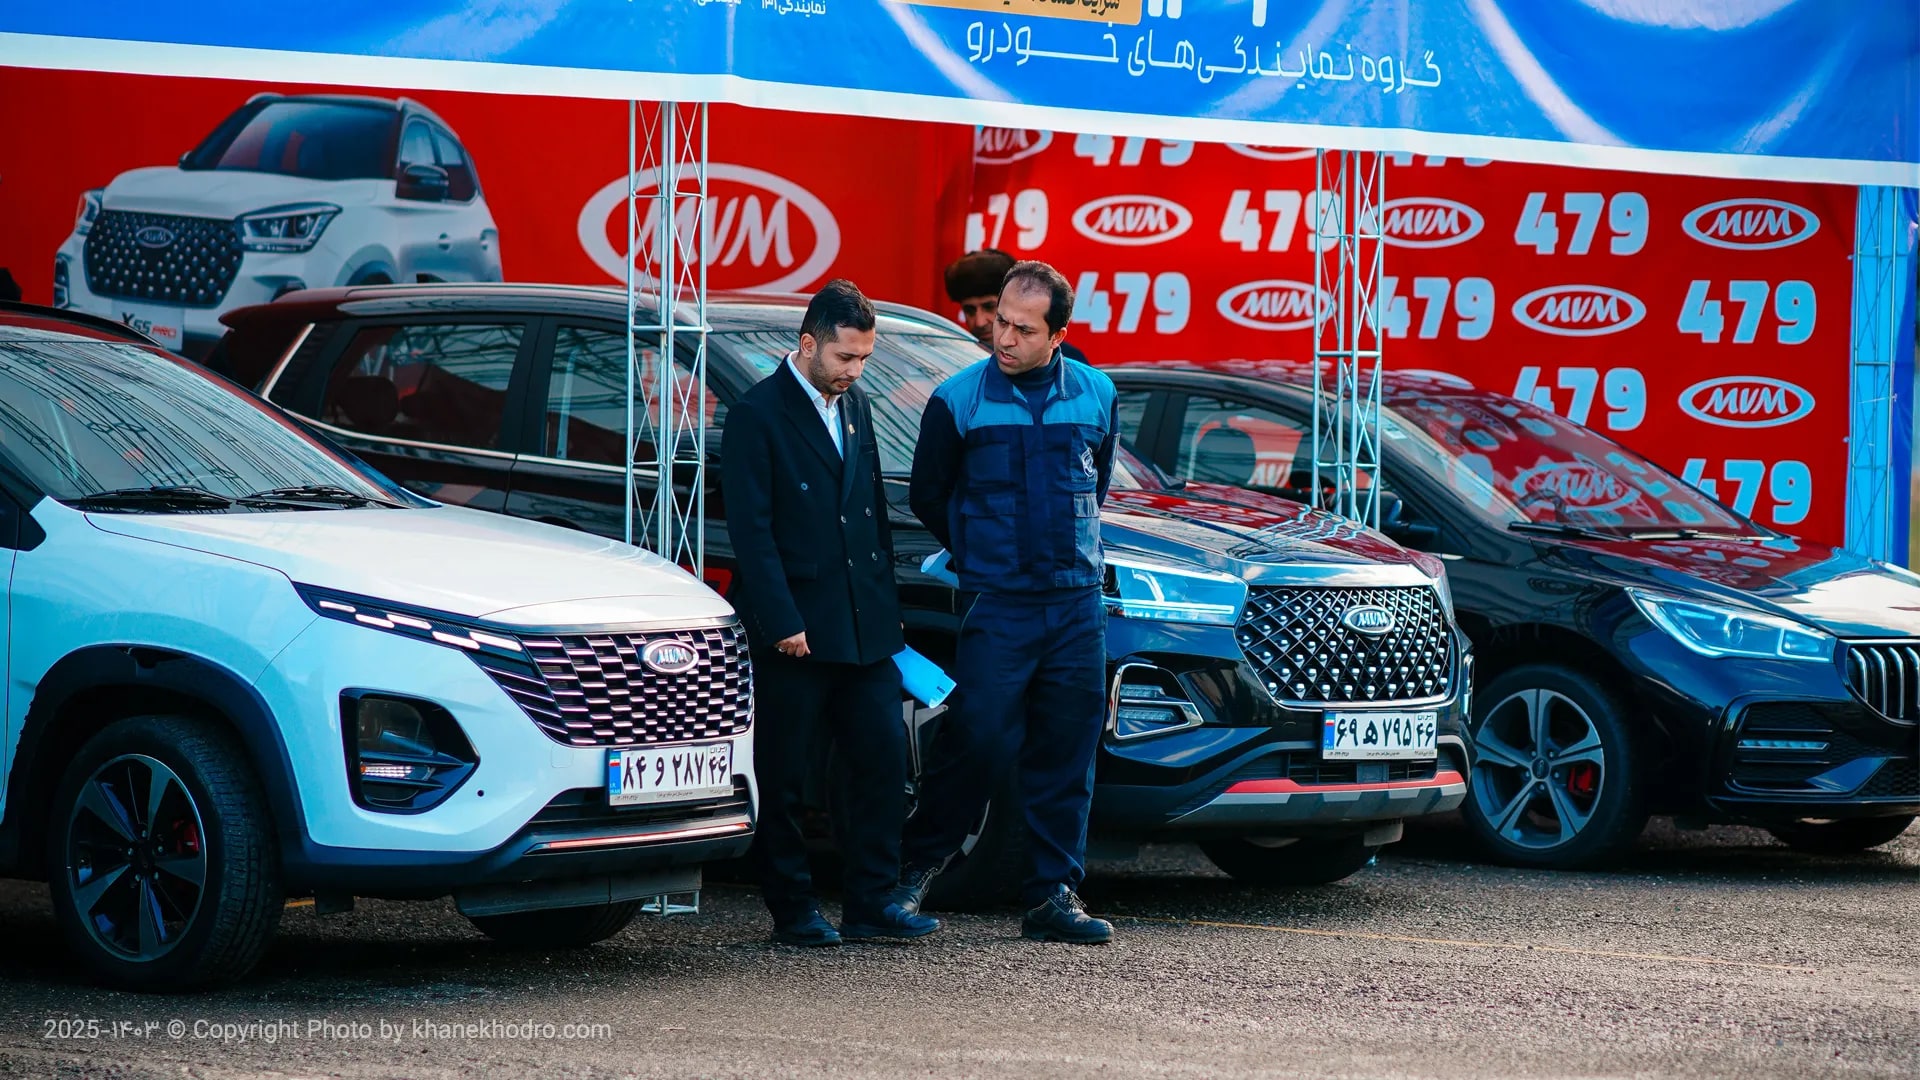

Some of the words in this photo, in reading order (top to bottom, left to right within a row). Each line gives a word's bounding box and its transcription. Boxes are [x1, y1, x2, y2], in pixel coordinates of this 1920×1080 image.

[966, 20, 1120, 67] خودرو
[1362, 50, 1442, 94] گروه
[624, 194, 795, 268] MVM
[1092, 205, 1169, 233] MVM
[1219, 189, 1344, 253] 479
[1383, 208, 1462, 236] MVM
[1513, 191, 1650, 256] 479
[1705, 209, 1794, 237] MVM
[1071, 271, 1192, 335] 479
[1238, 290, 1319, 318] MVM
[1366, 276, 1496, 341] 479
[1533, 295, 1621, 323] MVM
[1676, 280, 1817, 345] 479
[1511, 366, 1647, 432] 479
[1700, 386, 1789, 415] MVM
[1680, 458, 1812, 525] 479
[1356, 611, 1388, 627] MVM
